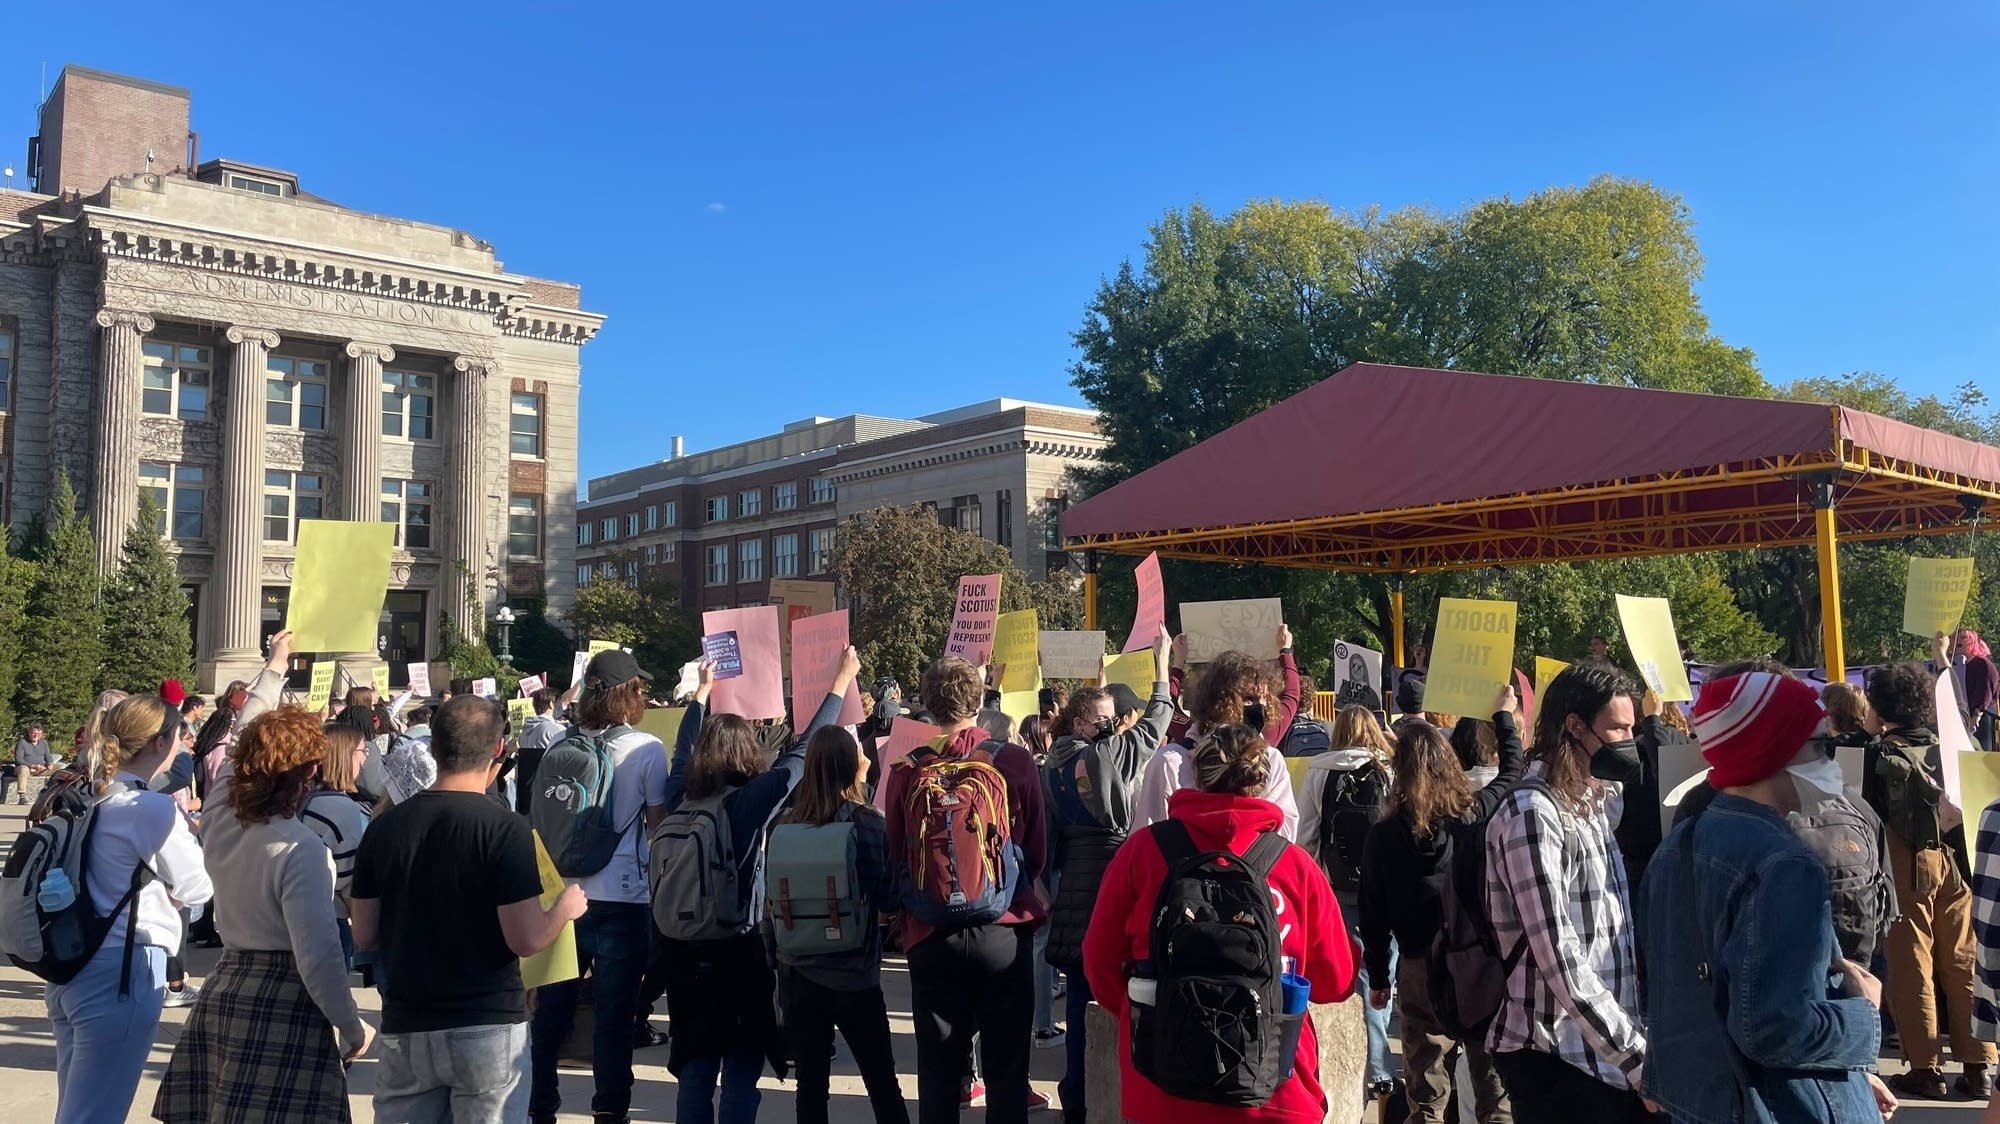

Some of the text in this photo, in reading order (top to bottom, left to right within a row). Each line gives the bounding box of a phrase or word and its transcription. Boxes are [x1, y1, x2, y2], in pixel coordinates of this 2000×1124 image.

[181, 269, 435, 325] ADMINISTRATION
[962, 583, 987, 597] FUCK
[959, 599, 997, 613] SCOTUS!
[956, 620, 972, 630] YOU
[953, 632, 991, 643] REPRESENT
[950, 644, 965, 654] US!
